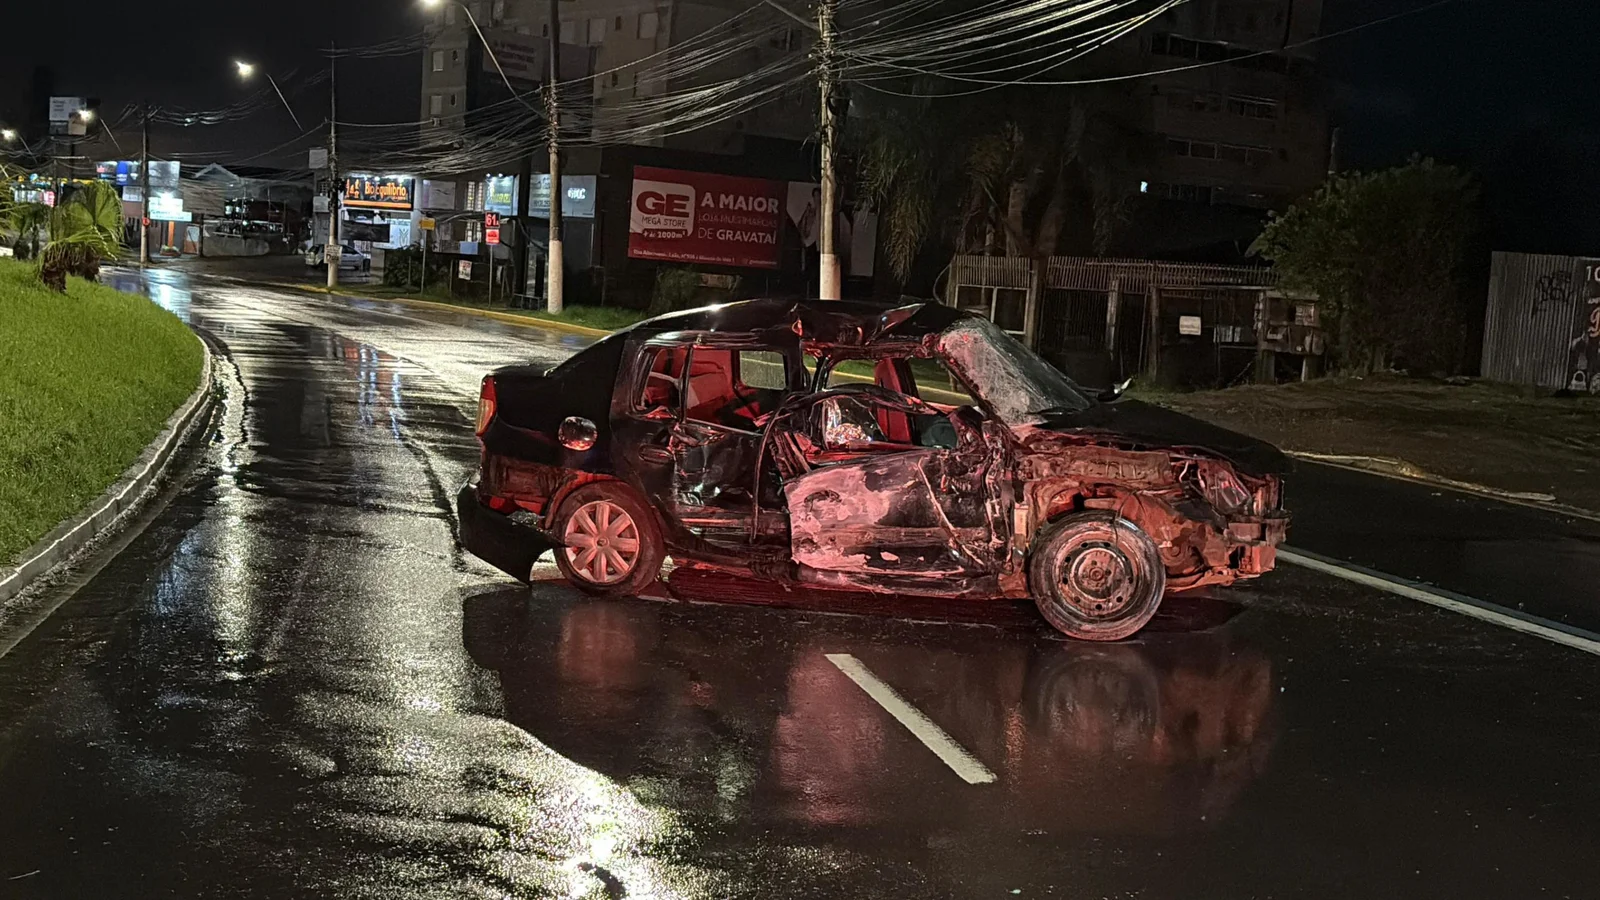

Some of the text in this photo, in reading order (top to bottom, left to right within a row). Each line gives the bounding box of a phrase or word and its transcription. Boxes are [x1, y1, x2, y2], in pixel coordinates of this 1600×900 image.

[636, 191, 690, 218] GE
[700, 192, 779, 214] A MAIOR
[641, 216, 686, 228] MEGA STORE
[698, 212, 718, 222] LOJA
[697, 227, 777, 245] DE GRAVATAÍ
